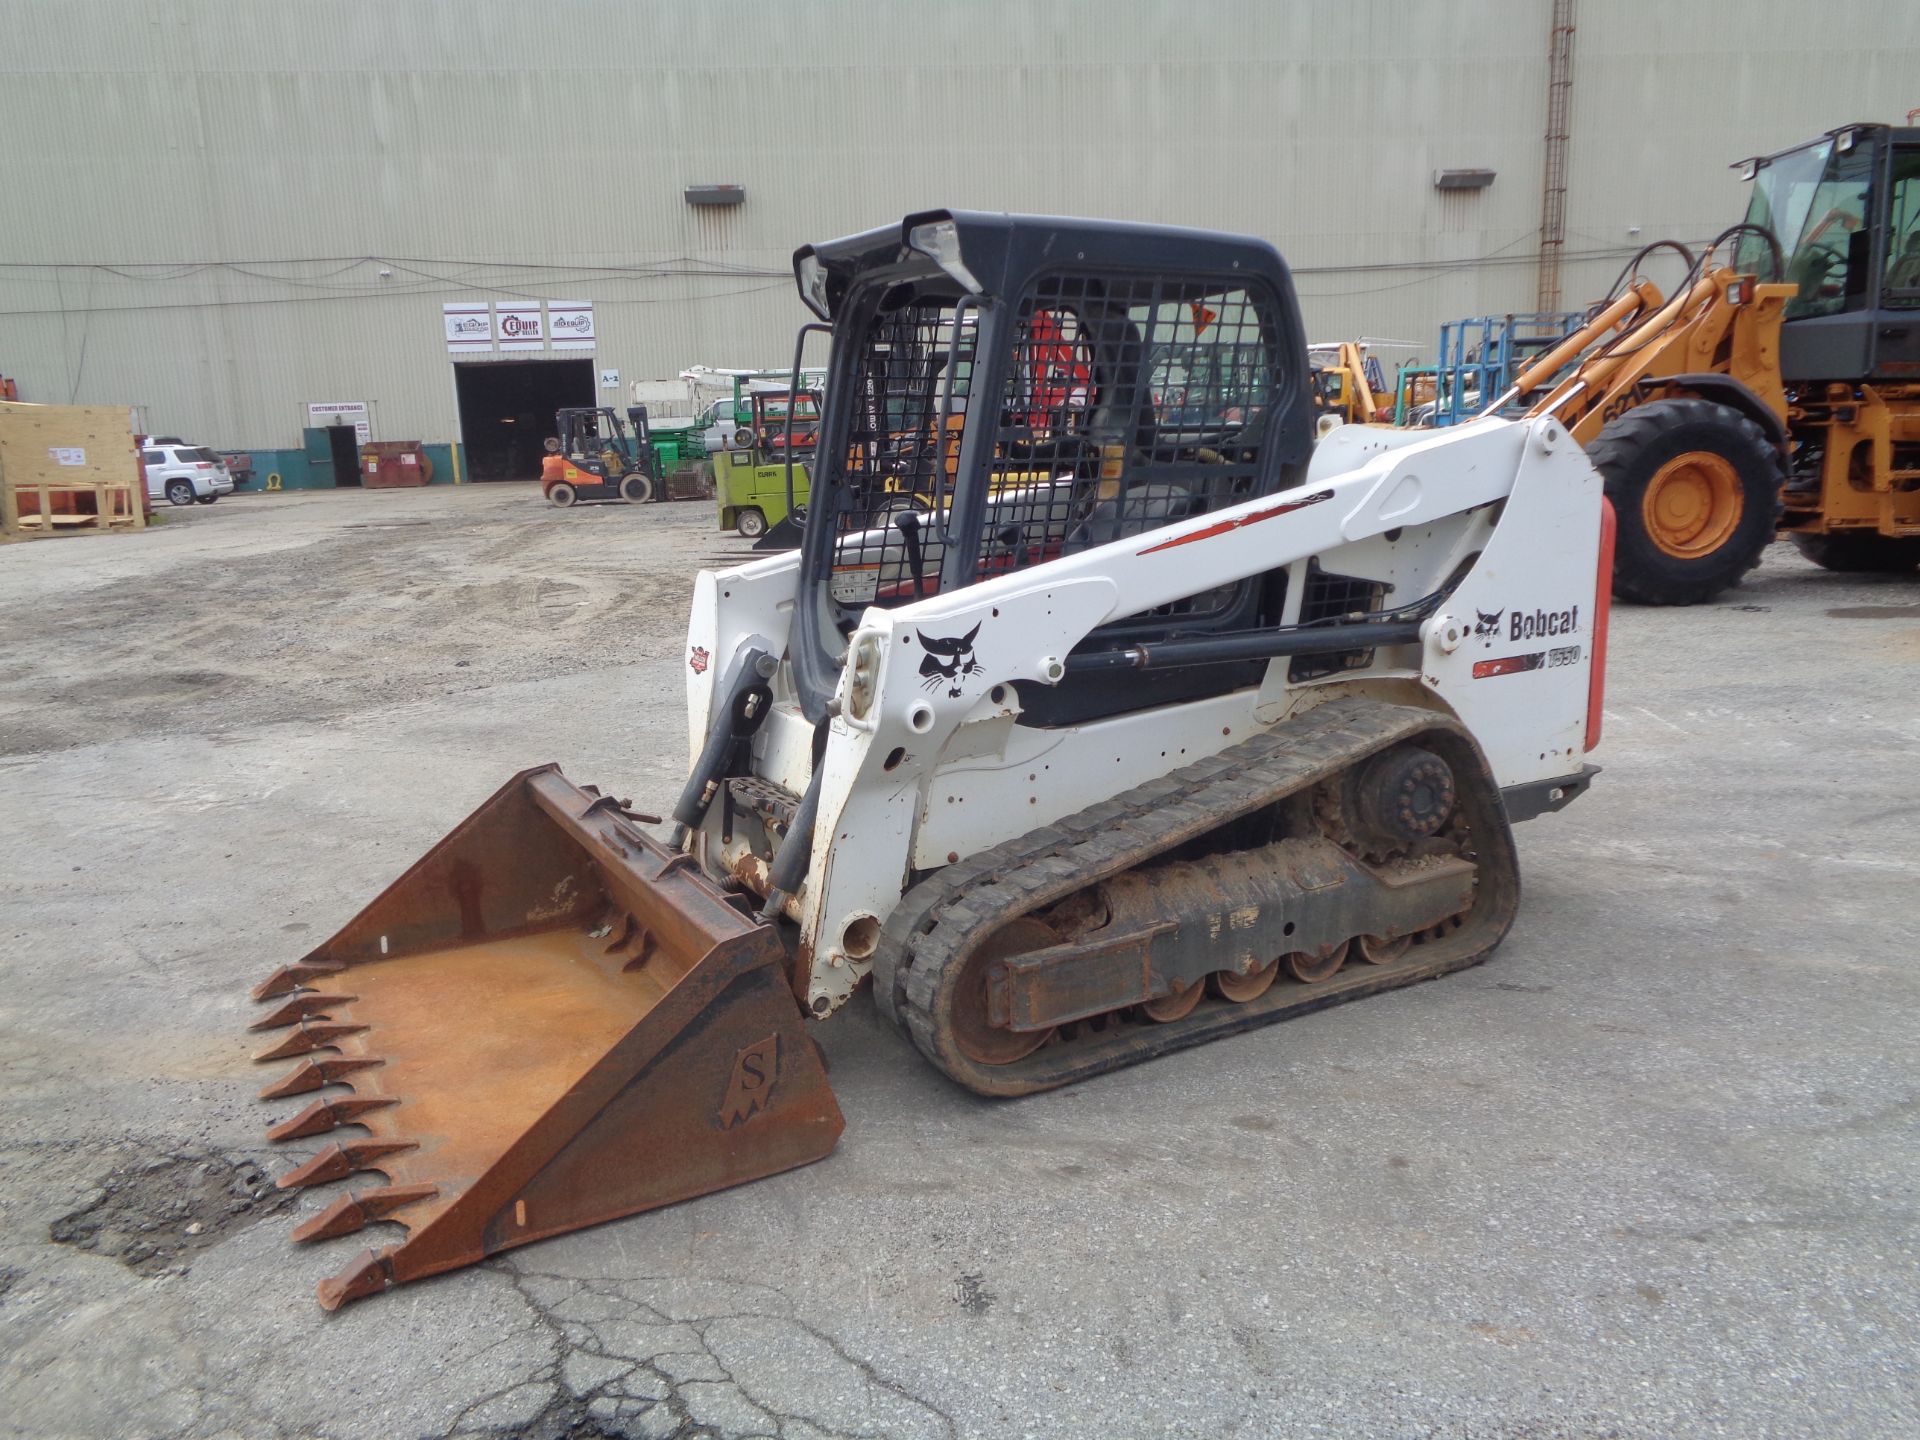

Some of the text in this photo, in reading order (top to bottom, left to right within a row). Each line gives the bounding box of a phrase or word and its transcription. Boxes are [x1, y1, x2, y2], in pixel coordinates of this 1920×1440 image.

[510, 320, 538, 331] EQUIP
[1510, 604, 1578, 641] Bobcat
[1548, 645, 1581, 669] T550
